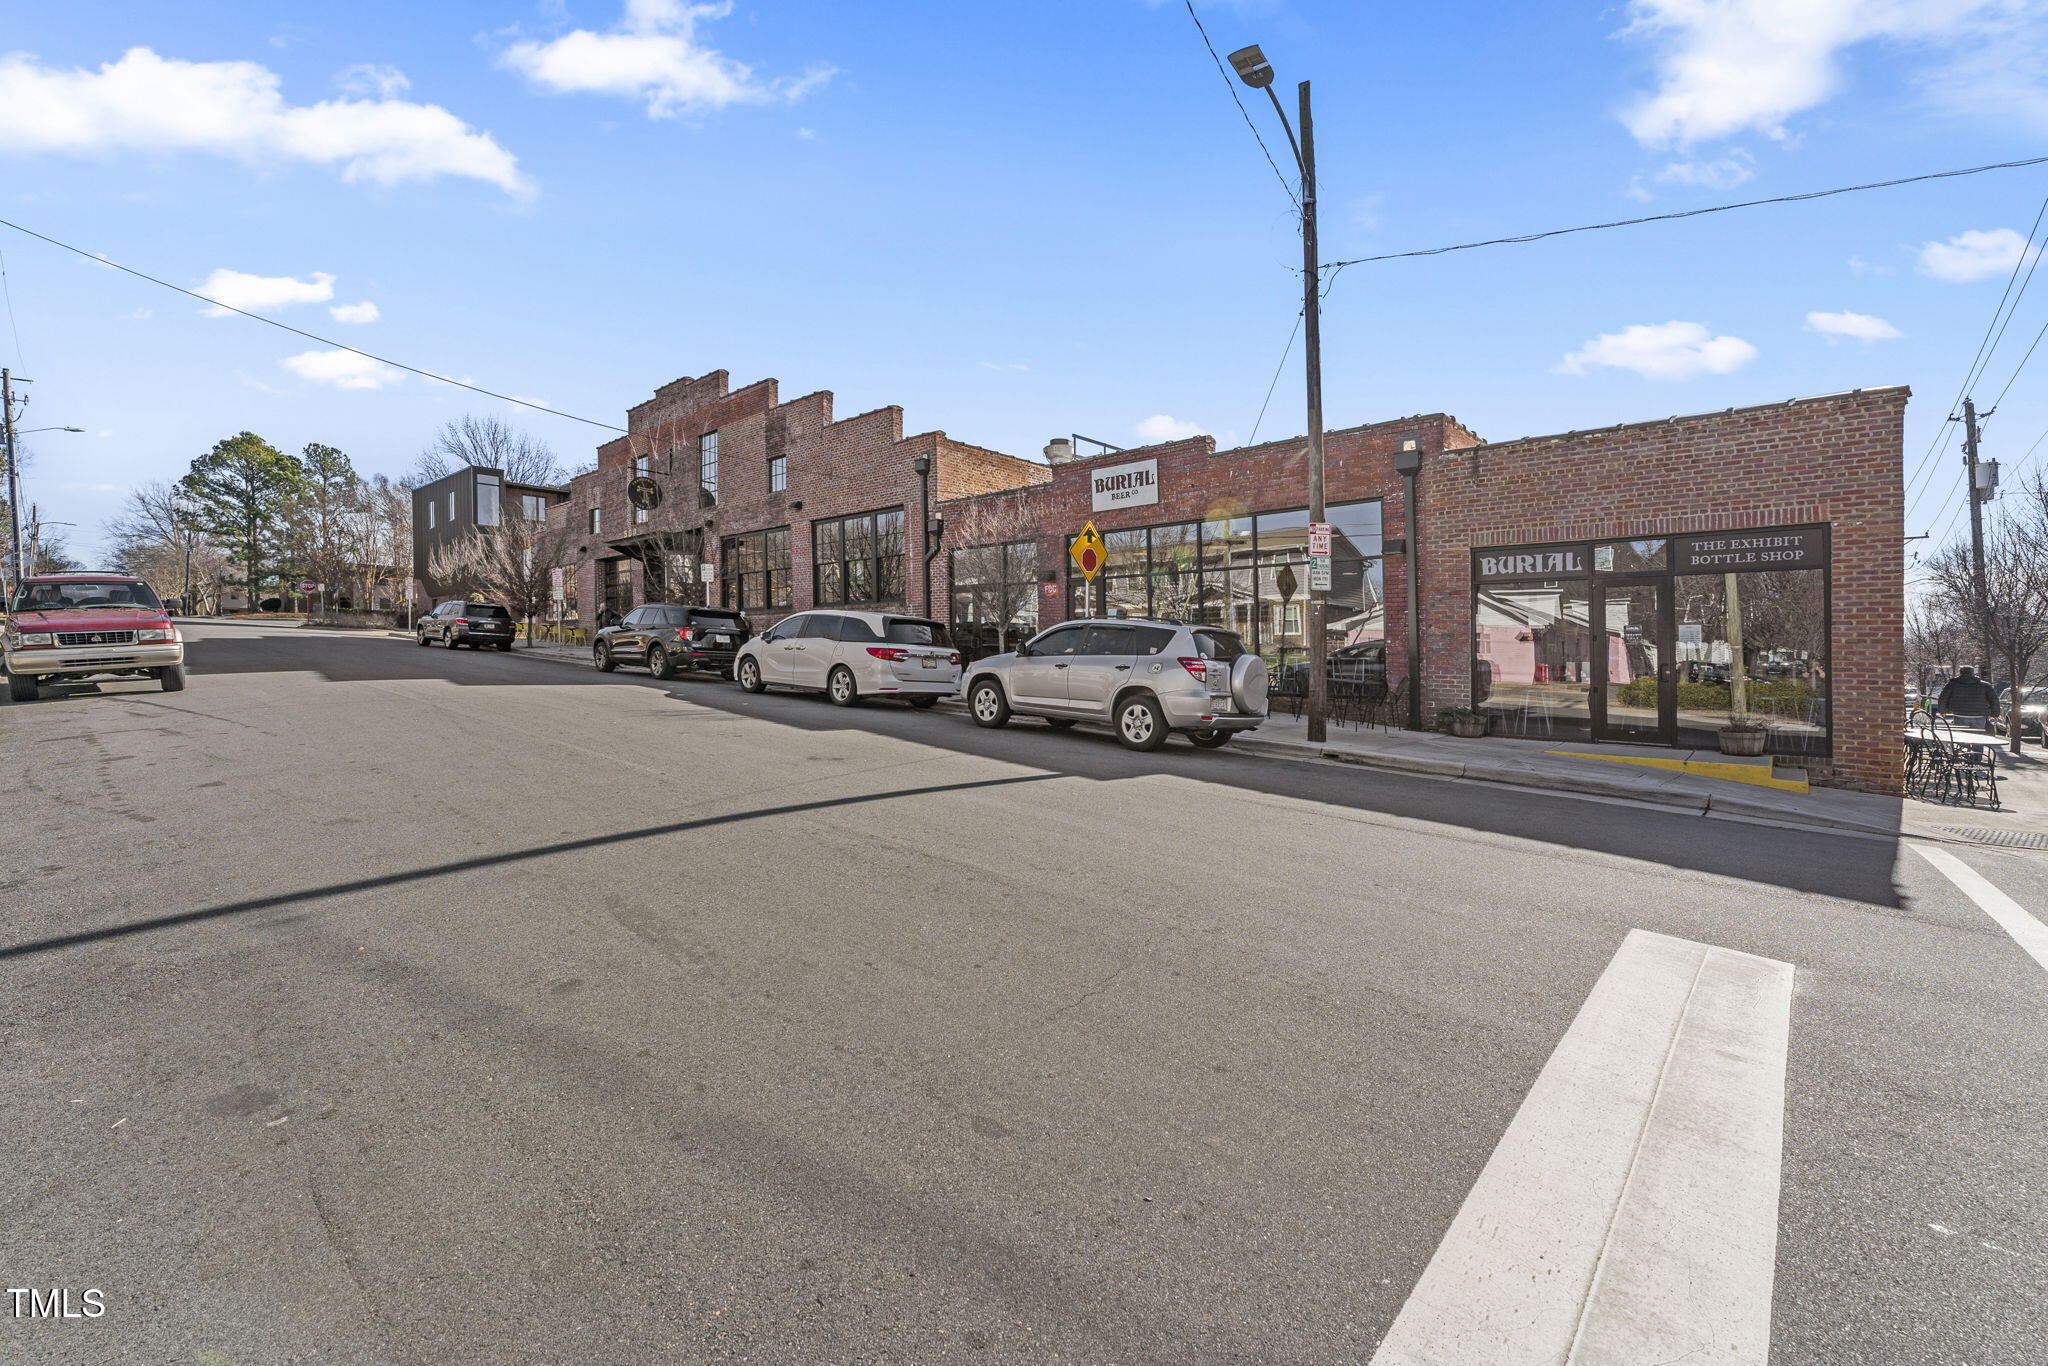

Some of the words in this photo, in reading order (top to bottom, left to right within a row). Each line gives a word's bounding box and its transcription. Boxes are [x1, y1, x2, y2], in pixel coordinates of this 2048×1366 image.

[1094, 470, 1155, 493] BURIAL
[1111, 491, 1131, 500] BEER
[1691, 540, 1726, 551] THE
[1730, 536, 1803, 549] EXHIBIT
[1312, 559, 1317, 567] 2
[1480, 552, 1583, 576] BURIAL
[1690, 552, 1757, 565] BOTTLE
[1760, 550, 1804, 561] SHOP
